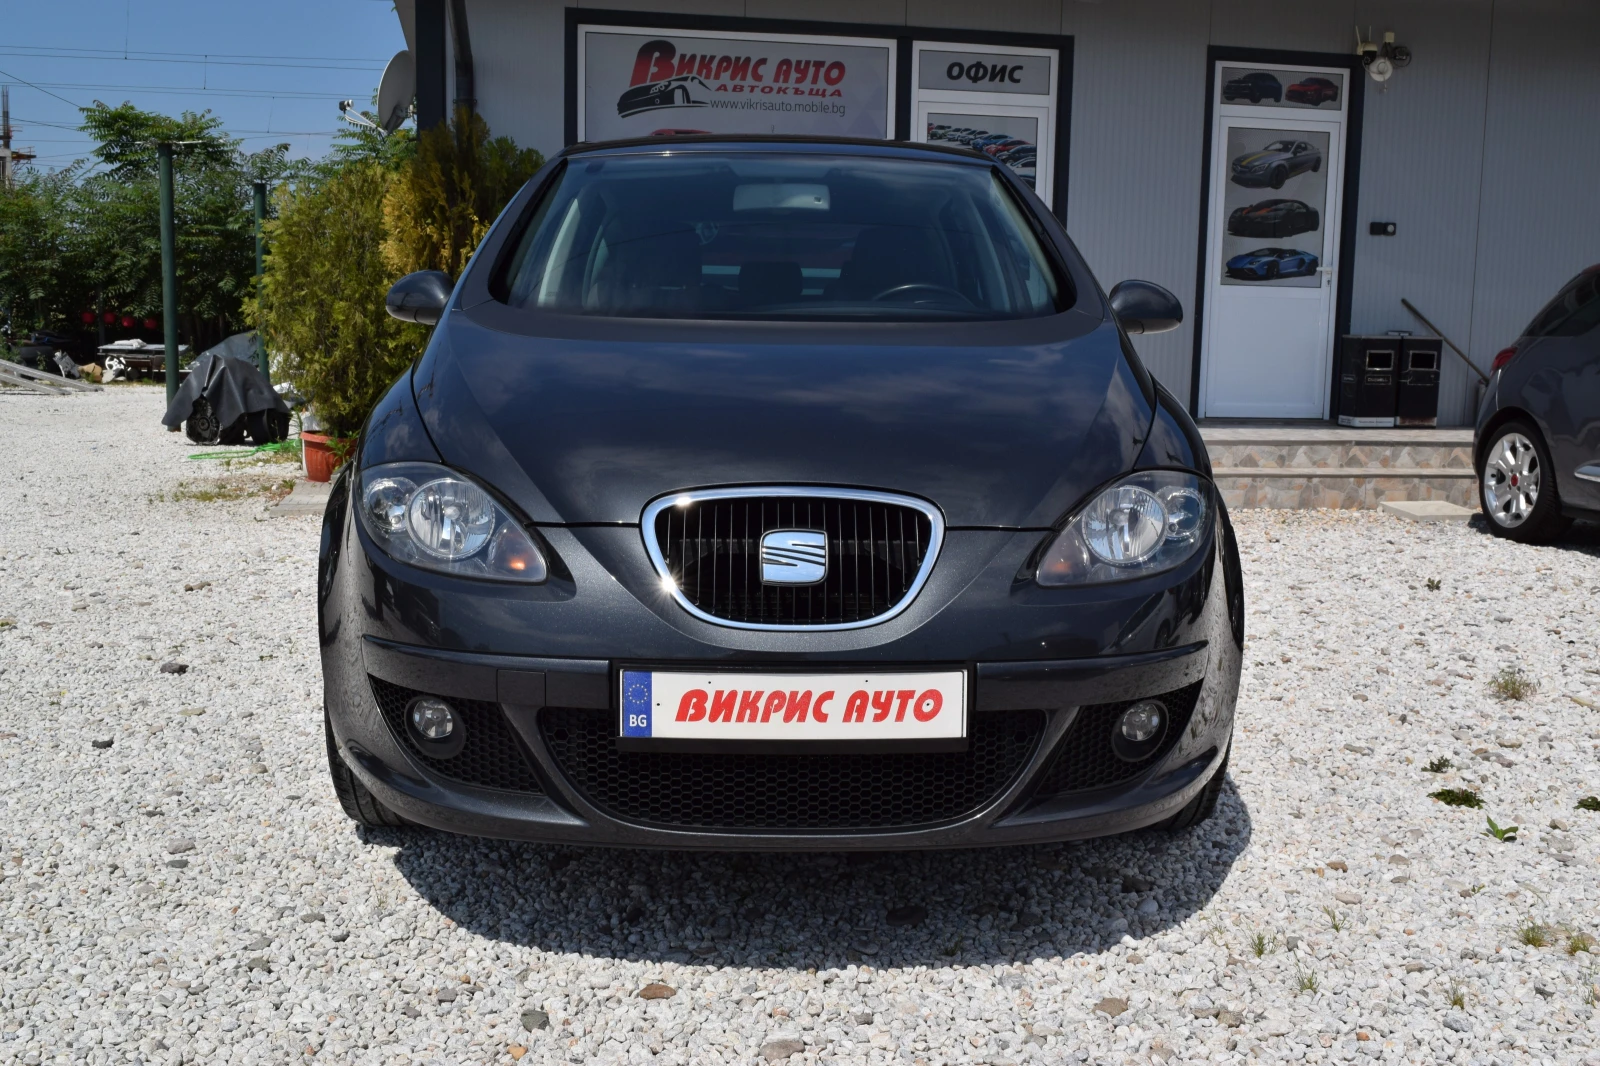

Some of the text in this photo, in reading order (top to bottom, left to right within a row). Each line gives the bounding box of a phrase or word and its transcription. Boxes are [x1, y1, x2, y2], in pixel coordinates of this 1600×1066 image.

[630, 39, 846, 87] ВИКРИС АУТО
[947, 61, 1024, 83] ОФИС
[715, 83, 843, 98] АВТОКЪЩА
[710, 98, 846, 117] www.vikrisauto.mobile.bg
[675, 689, 944, 723] ВИКРИС АУТО
[629, 714, 647, 727] BG
